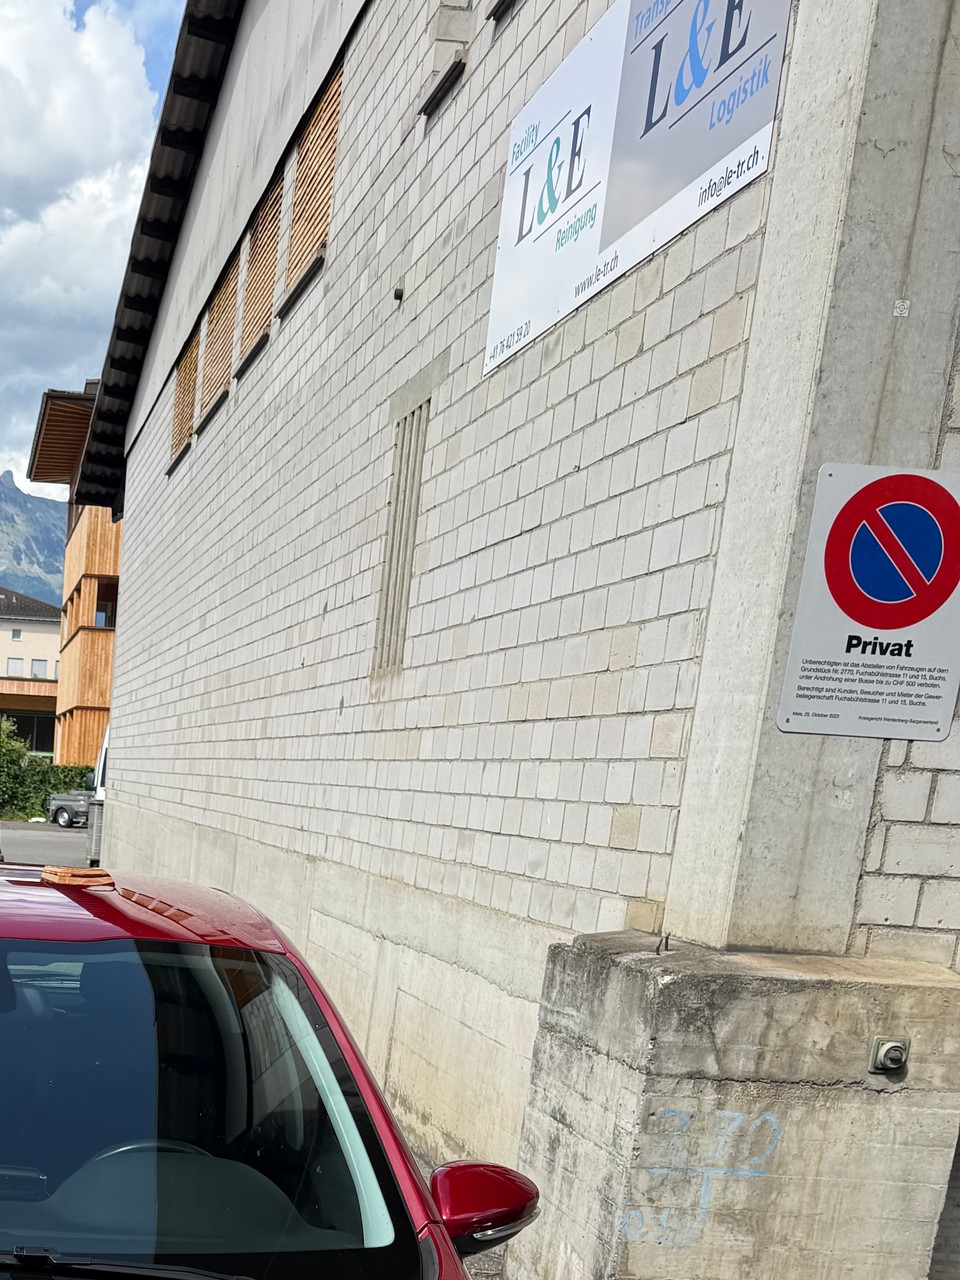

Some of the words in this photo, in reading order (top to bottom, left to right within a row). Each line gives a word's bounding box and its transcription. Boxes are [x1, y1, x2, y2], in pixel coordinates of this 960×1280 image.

[709, 53, 771, 131] Logistik
[511, 121, 541, 166] Facility
[514, 104, 592, 247] L&E
[697, 145, 759, 207] info@le-tr.ch
[555, 203, 597, 252] Reinigung
[574, 251, 619, 298] www.le-tr.ch
[506, 331, 516, 350] 421
[845, 635, 914, 658] Privat
[800, 666, 831, 674] Grundstück
[802, 658, 842, 667] Unberechtigten
[861, 662, 885, 670] Abstellen
[896, 664, 926, 673] Fahrzeugen
[814, 675, 843, 683] Androhung
[797, 685, 824, 693] Berechtigt
